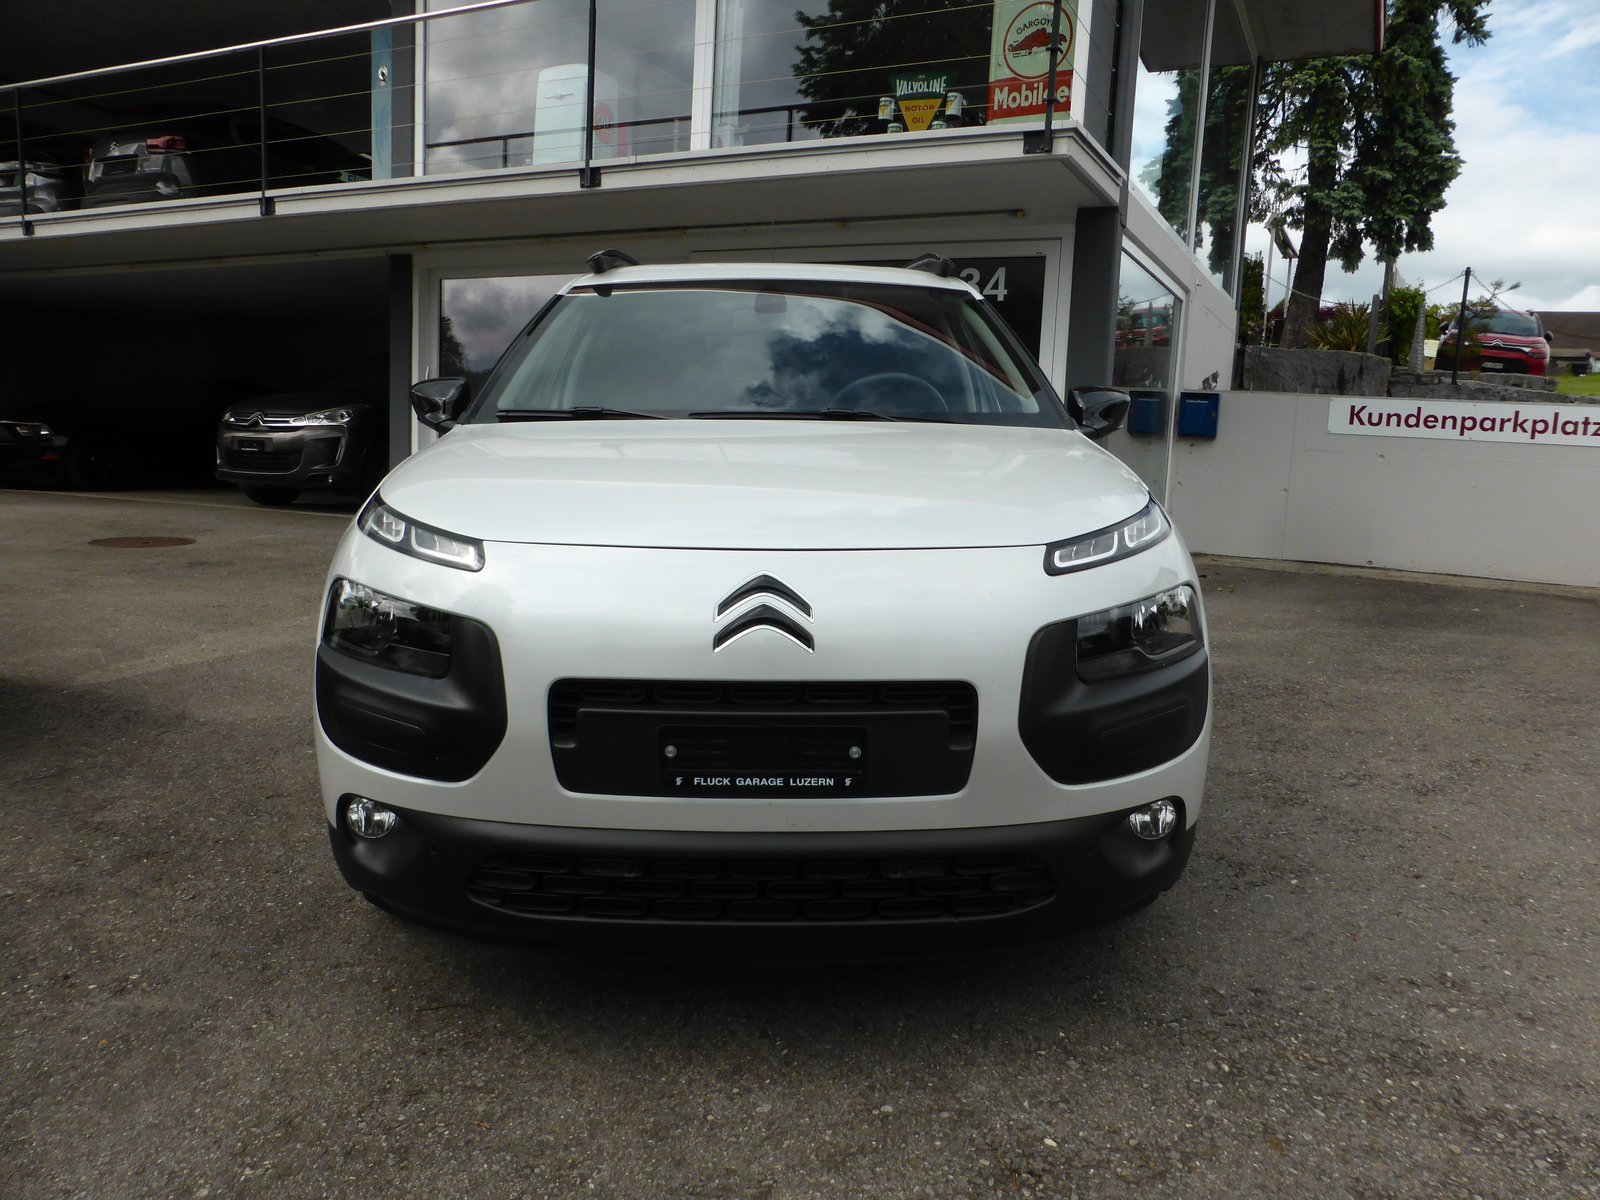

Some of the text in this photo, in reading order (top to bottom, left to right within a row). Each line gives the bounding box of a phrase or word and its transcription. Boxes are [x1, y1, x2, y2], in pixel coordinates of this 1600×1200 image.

[1016, 17, 1053, 35] GARGOY
[896, 76, 947, 97] VALVOLINE
[904, 104, 935, 112] MOTOR
[1348, 404, 1600, 440] Kundenparkplatz
[693, 777, 834, 786] FLUCK GARAGE LUZERN
